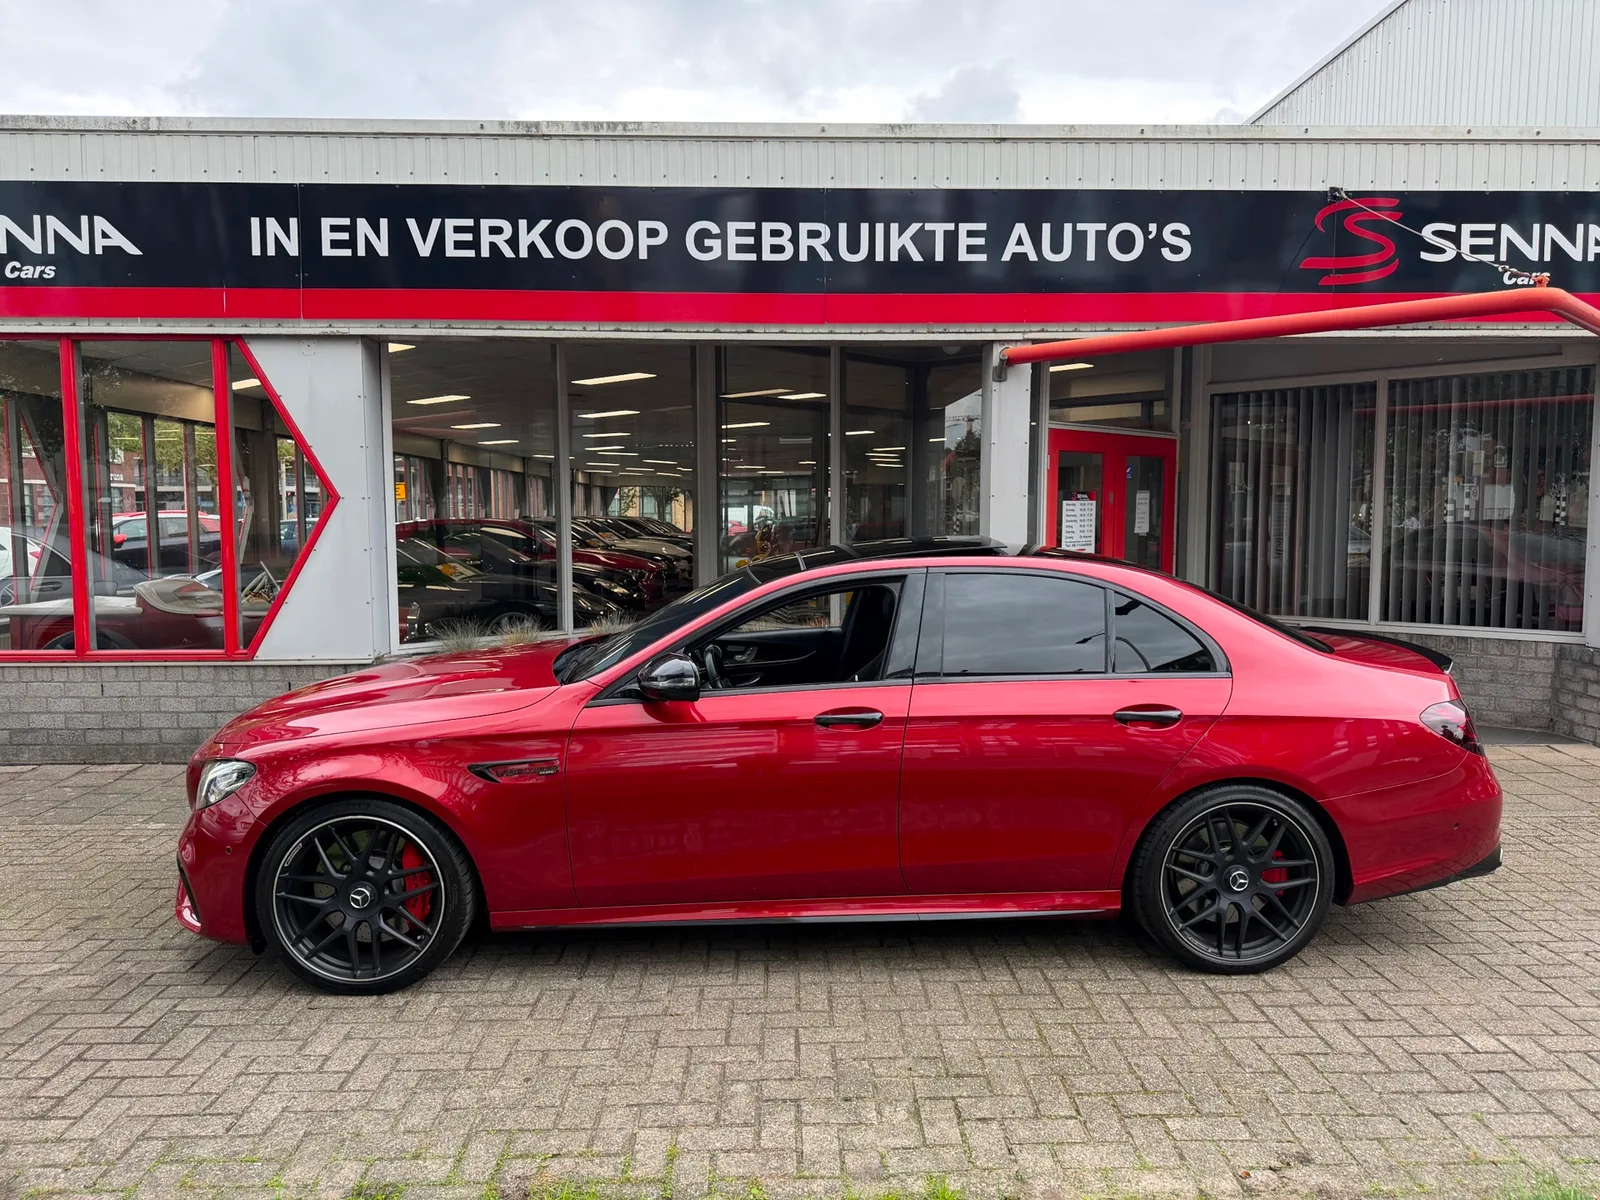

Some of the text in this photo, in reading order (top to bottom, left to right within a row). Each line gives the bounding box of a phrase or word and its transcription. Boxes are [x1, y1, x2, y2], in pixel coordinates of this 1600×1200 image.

[250, 216, 1192, 263] IN EN VERKOOP GEBRUIKTE AUTO'S
[1419, 222, 1600, 262] SENN
[4, 260, 57, 279] Cars
